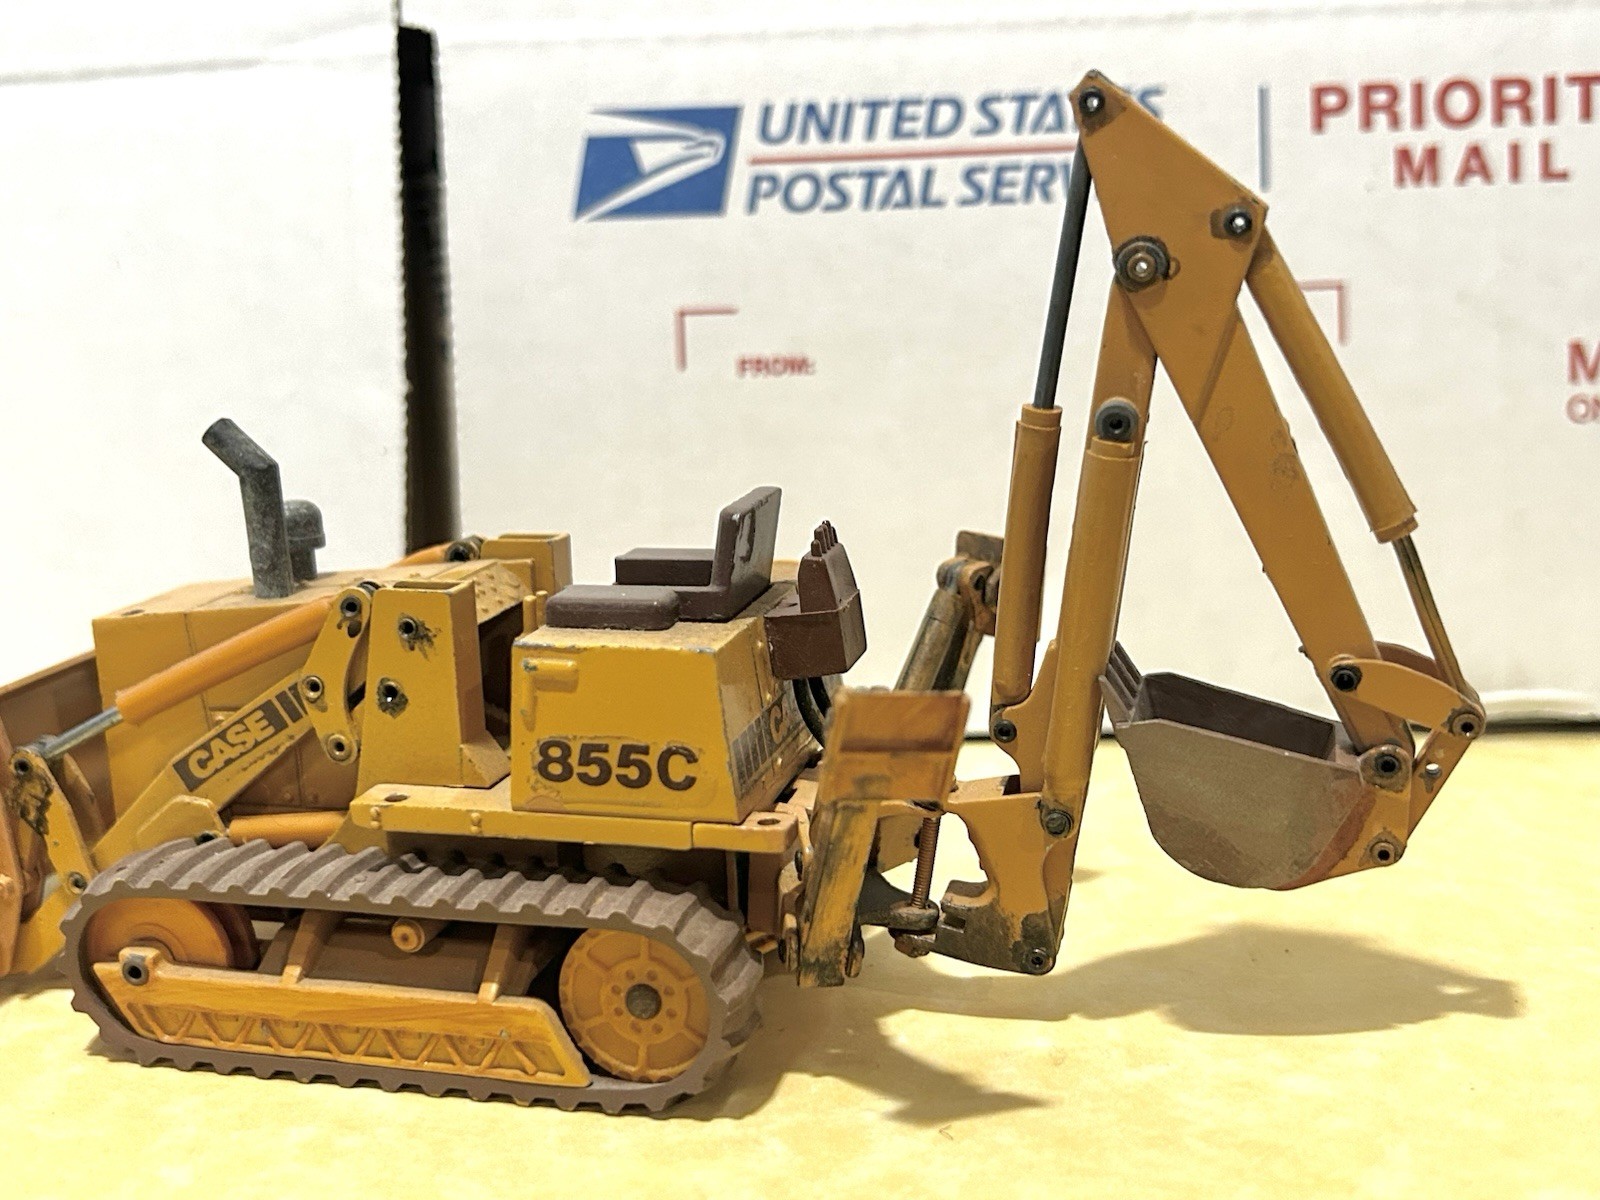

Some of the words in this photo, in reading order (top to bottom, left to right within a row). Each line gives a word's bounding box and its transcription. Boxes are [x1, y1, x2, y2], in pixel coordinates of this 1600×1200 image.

[759, 95, 962, 145] UNITED
[973, 85, 1165, 137] STAS
[1310, 73, 1600, 133] PRIORIT
[746, 167, 946, 214] POSTAL
[1394, 140, 1569, 187] MAIL
[188, 709, 275, 779] CASE
[537, 740, 699, 791] 855C
